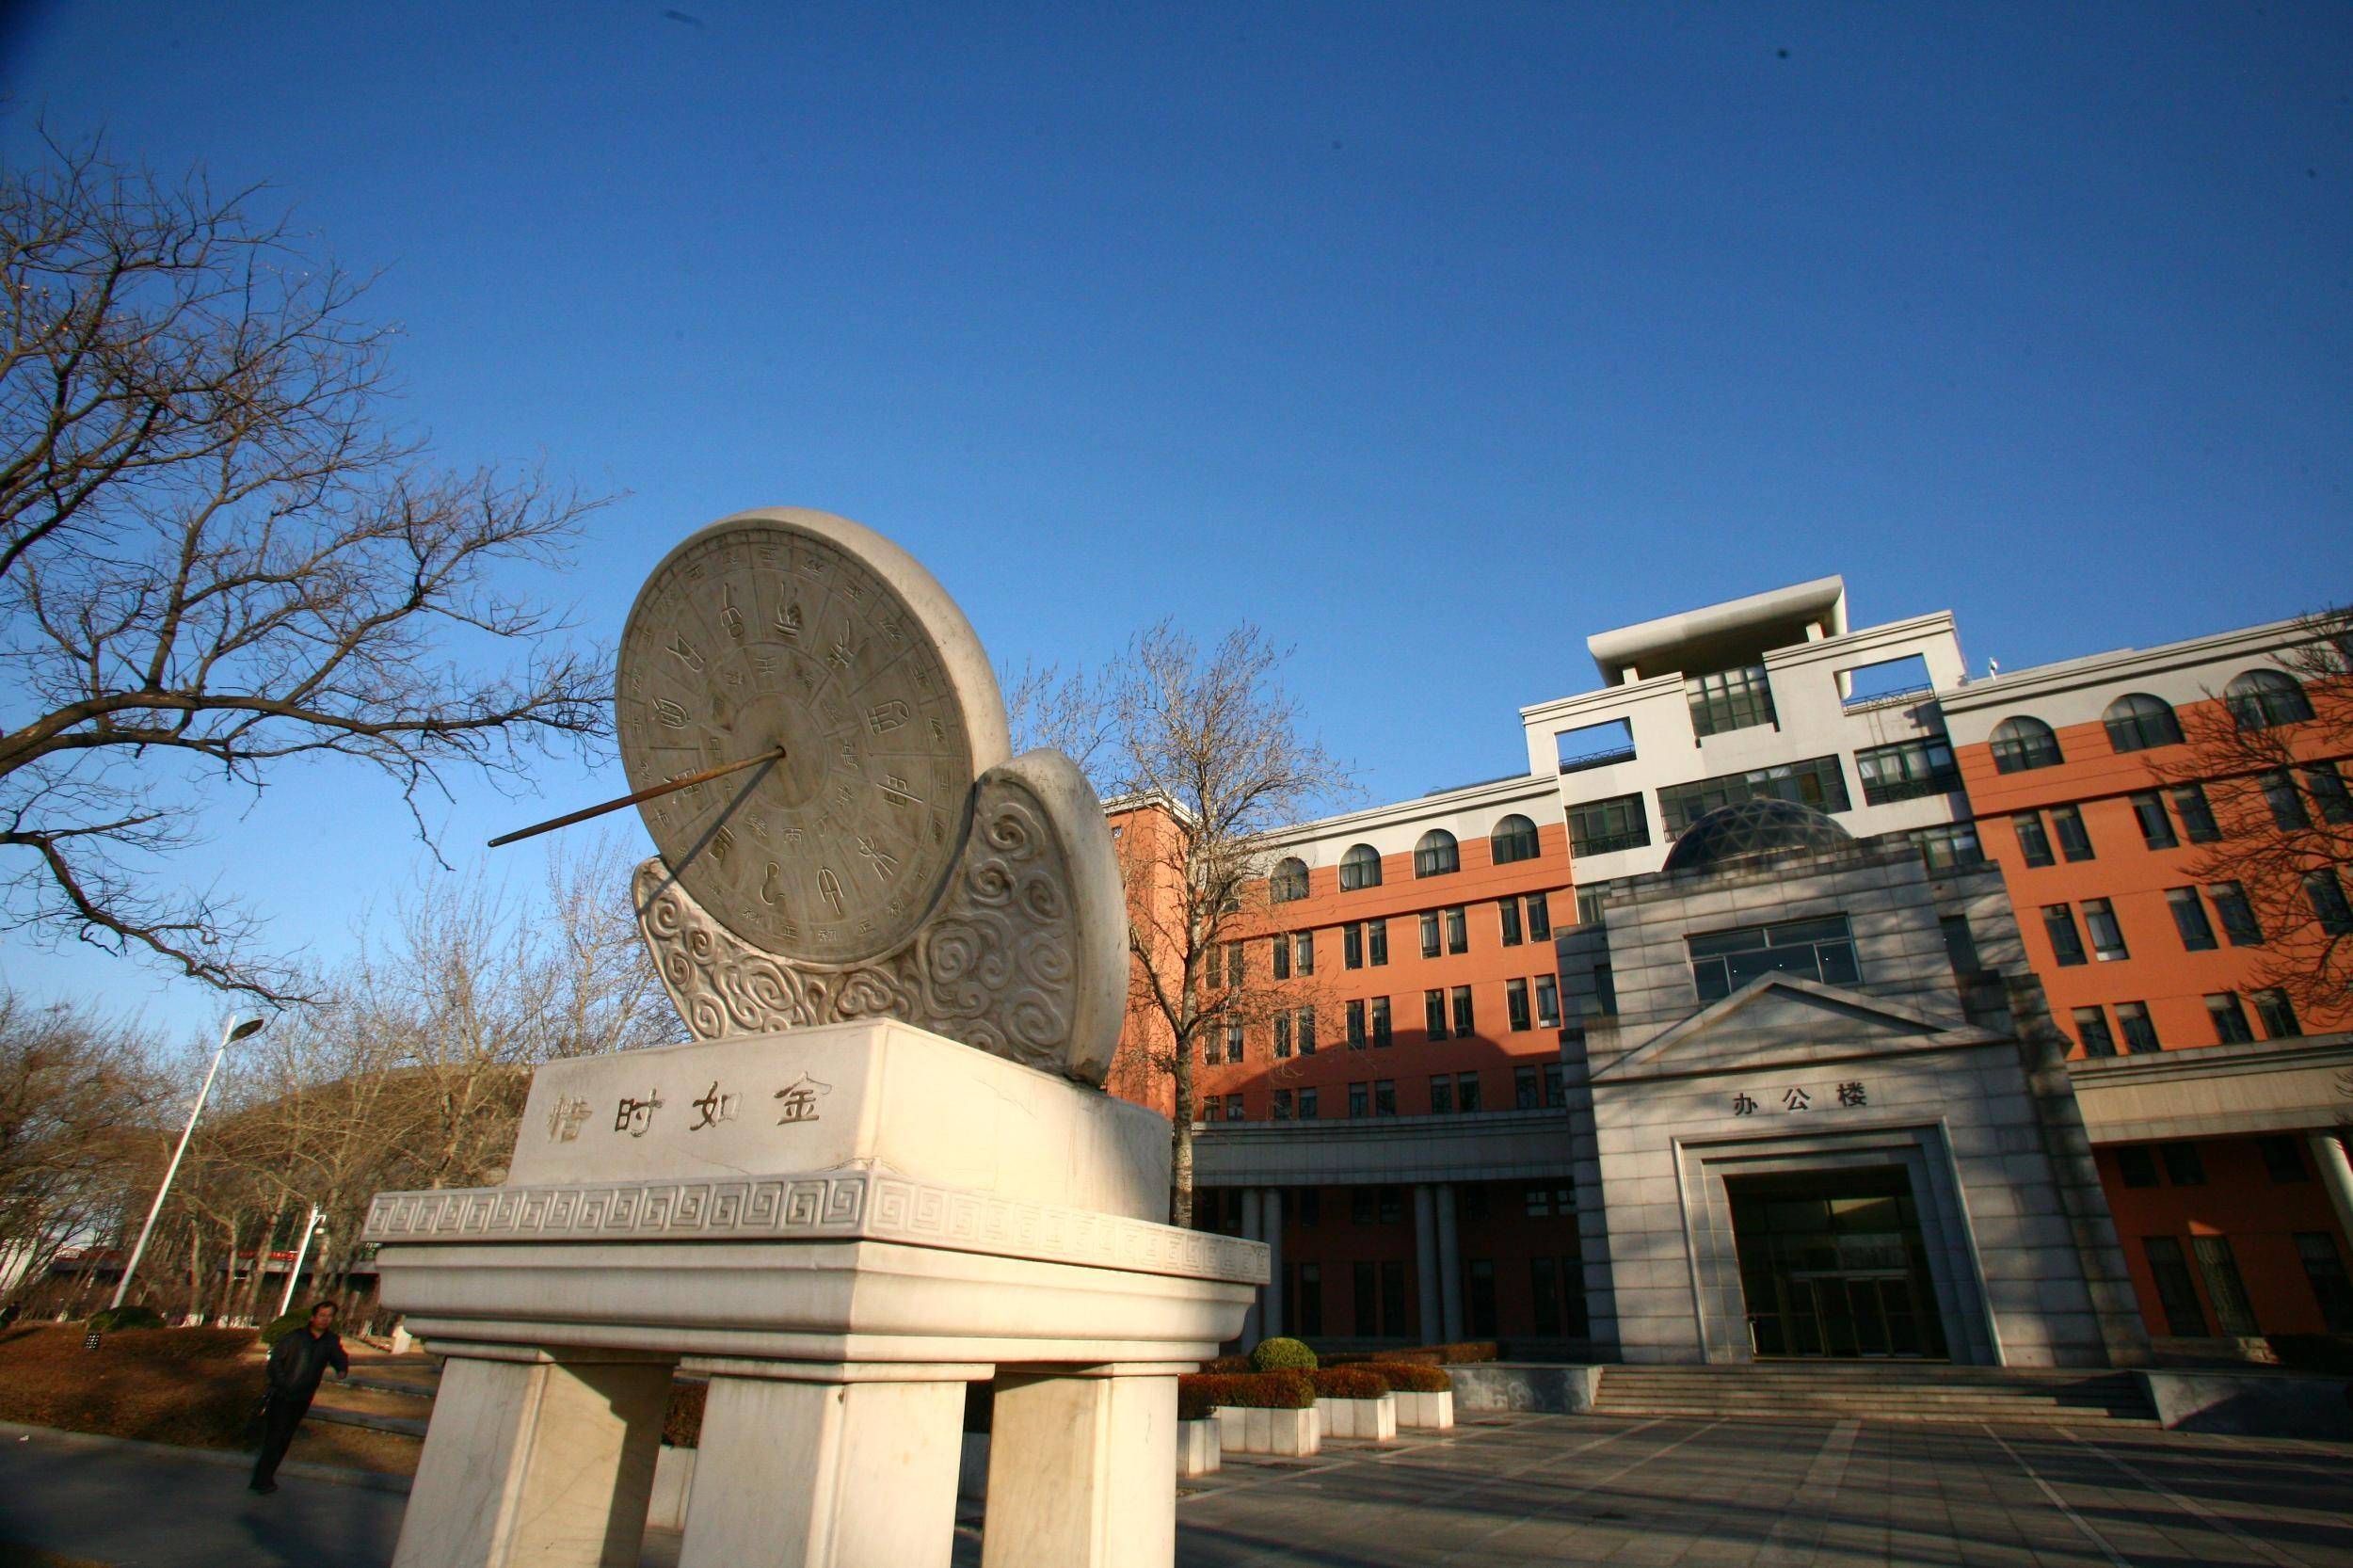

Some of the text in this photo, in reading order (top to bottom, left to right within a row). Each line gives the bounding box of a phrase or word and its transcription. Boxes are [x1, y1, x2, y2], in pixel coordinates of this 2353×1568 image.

[547, 1071, 832, 1144] 惜时如金
[1733, 1082, 1867, 1116] 办公楼
